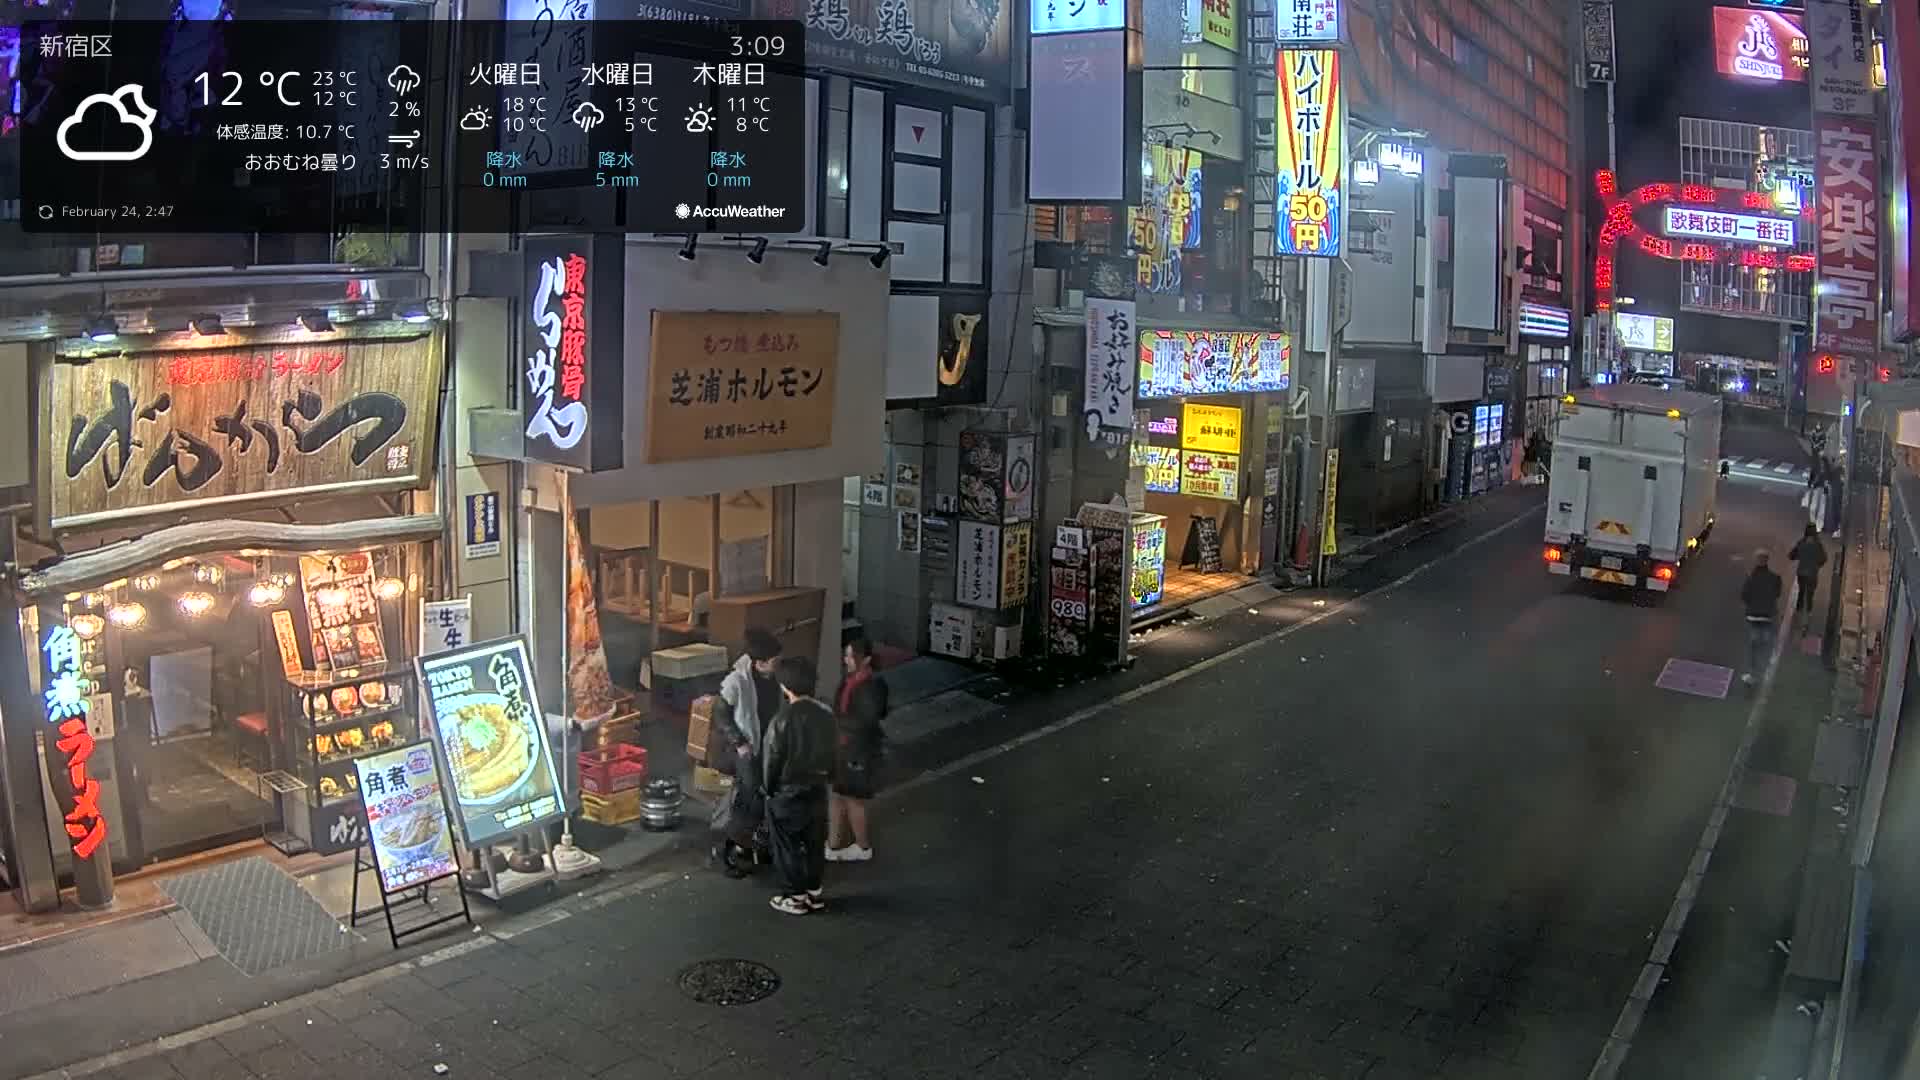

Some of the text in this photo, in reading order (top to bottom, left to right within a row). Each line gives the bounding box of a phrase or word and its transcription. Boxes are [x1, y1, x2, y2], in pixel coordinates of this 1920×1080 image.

[1296, 54, 1322, 190] ハイボール
[1669, 210, 1793, 242] 歌舞伎町一番街
[1820, 127, 1876, 330] 安楽亭
[561, 252, 587, 401] 東京豚骨
[669, 366, 825, 406] 芝浦ホルモン
[427, 664, 472, 687] TOKYO
[493, 655, 529, 722] 角煮
[364, 763, 409, 798] 角煮
